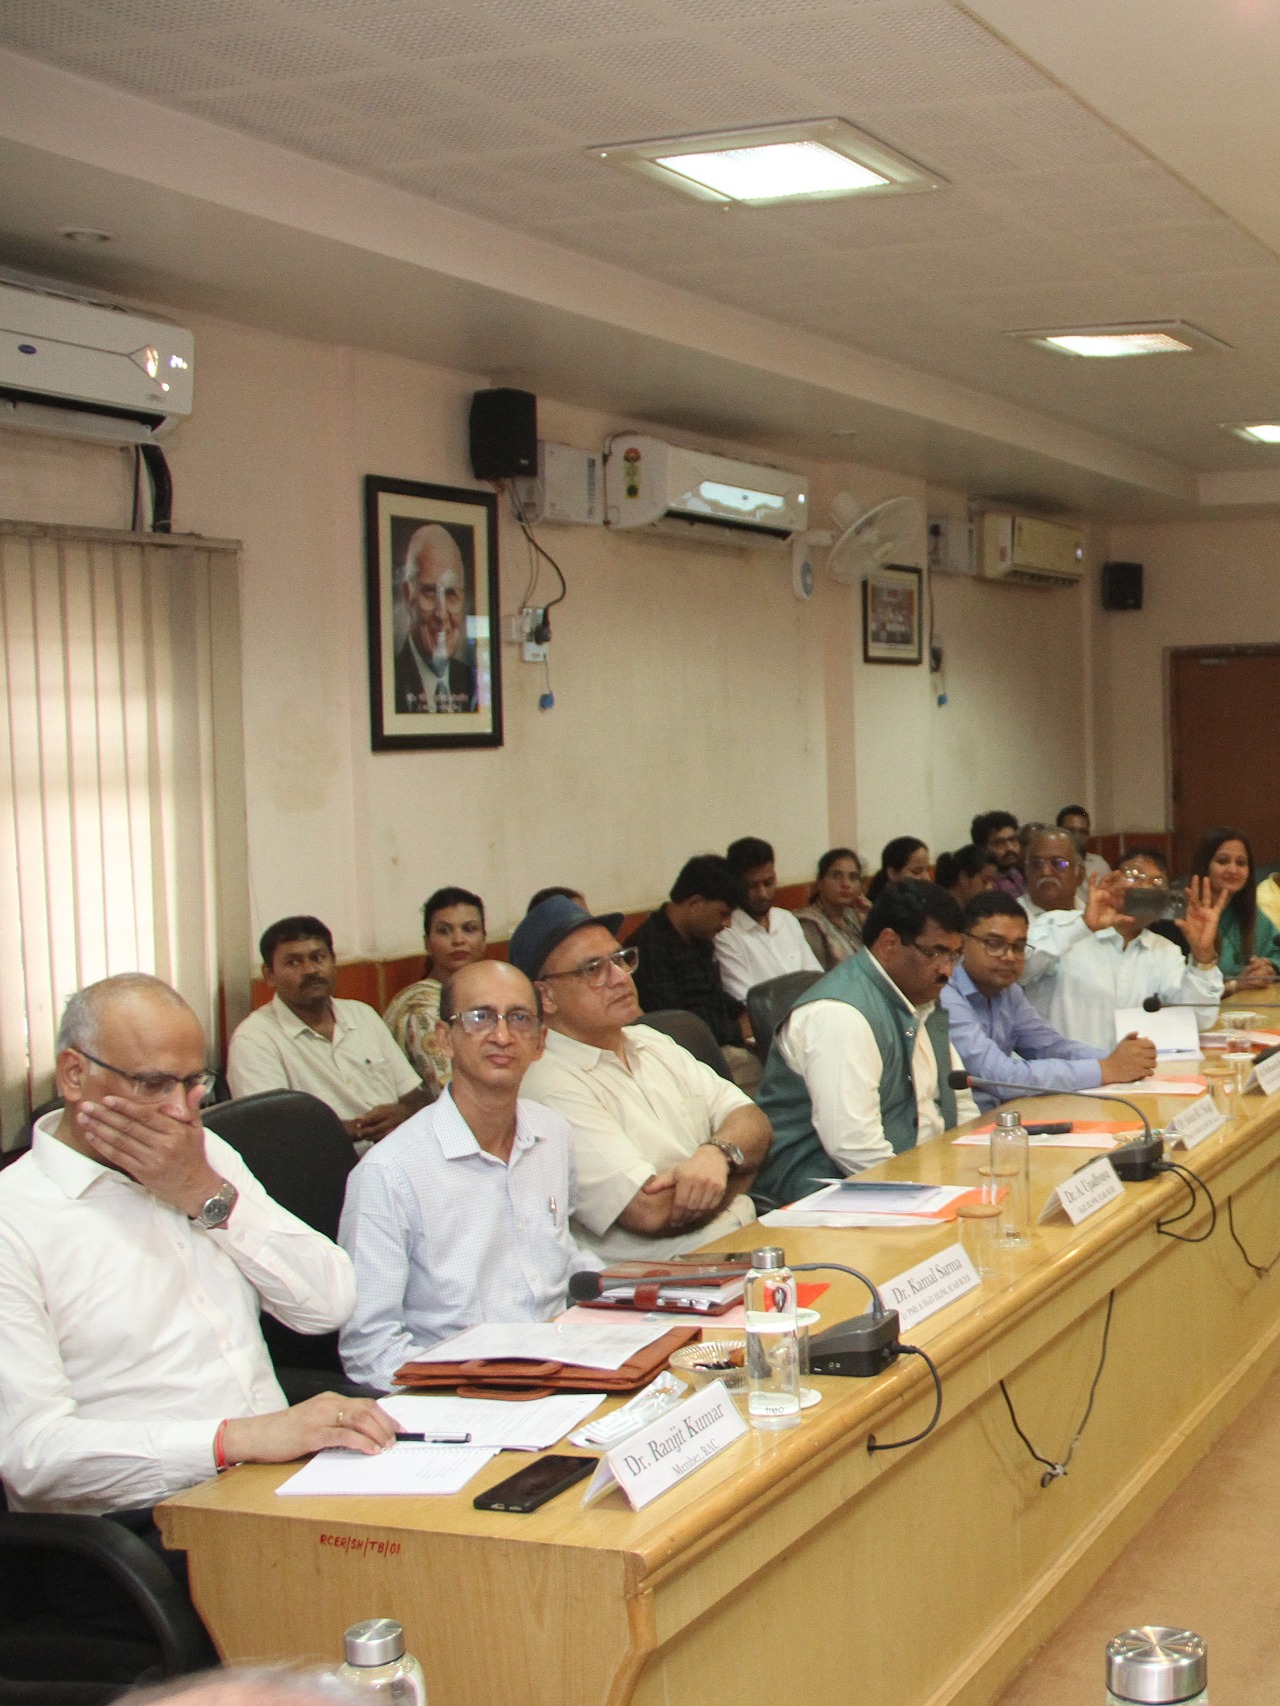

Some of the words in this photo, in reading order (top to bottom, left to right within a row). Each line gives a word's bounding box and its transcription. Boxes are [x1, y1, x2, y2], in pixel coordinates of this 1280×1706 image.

[891, 1287, 911, 1304] Dr.
[907, 1267, 937, 1294] Kamal
[935, 1258, 963, 1279] Sarma
[623, 1454, 651, 1477] Dr.
[647, 1426, 685, 1462] Ranjit
[682, 1403, 724, 1438] Kumar
[701, 1438, 720, 1457] RAC
